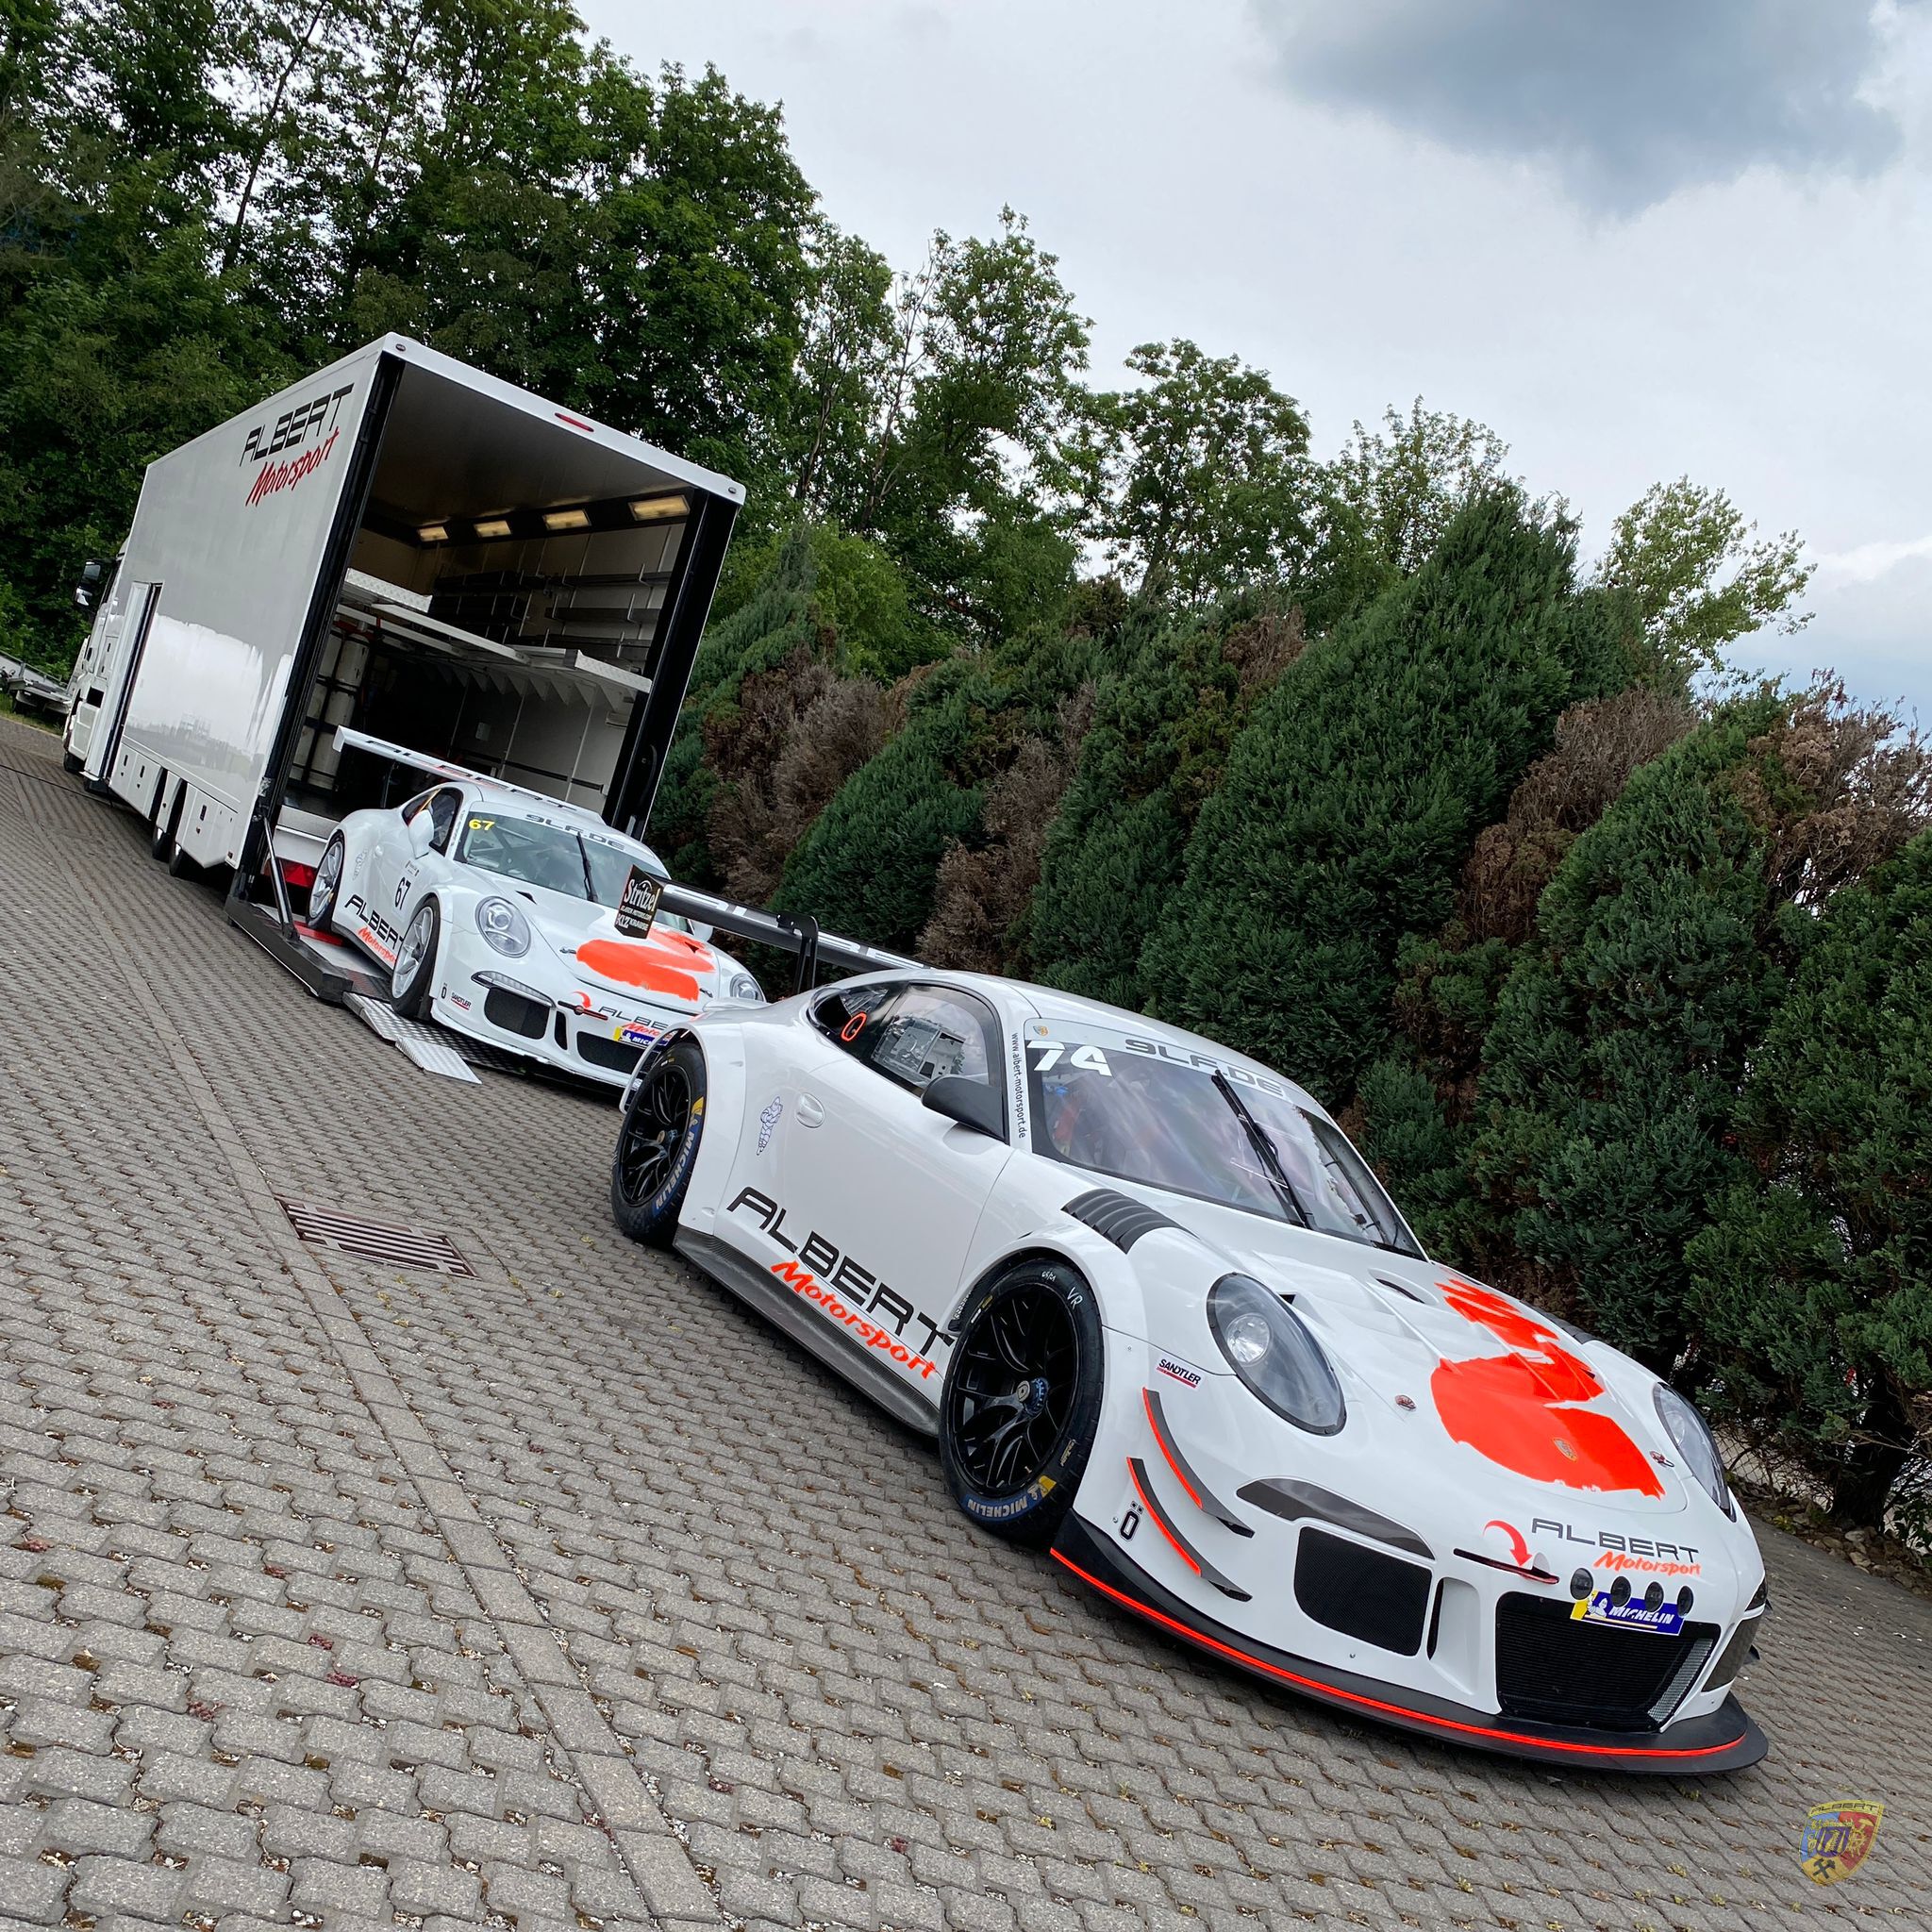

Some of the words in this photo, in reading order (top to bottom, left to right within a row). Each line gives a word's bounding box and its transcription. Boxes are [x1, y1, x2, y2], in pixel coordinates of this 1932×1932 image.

[240, 382, 355, 467] ALBERT
[245, 425, 340, 508] Motorsport
[469, 819, 494, 831] 67
[394, 877, 411, 910] 67
[623, 878, 660, 911] Stritzel
[344, 894, 404, 950] ALBER
[598, 1006, 669, 1030] ALBE
[1027, 1041, 1113, 1076] 74
[1011, 1032, 1027, 1139] www.albert-motorsport.de
[655, 1132, 696, 1210] MICHELIN
[726, 1186, 955, 1357] ALBERT
[1067, 1286, 1084, 1310] VR
[770, 1259, 937, 1379] Motorsport
[1158, 1358, 1202, 1385] SANDTLER
[967, 1495, 1028, 1517] MICHELIN
[1532, 1517, 1700, 1563] ALBERT
[1593, 1551, 1703, 1576] Motorsport
[1608, 1606, 1675, 1625] MICHELIN
